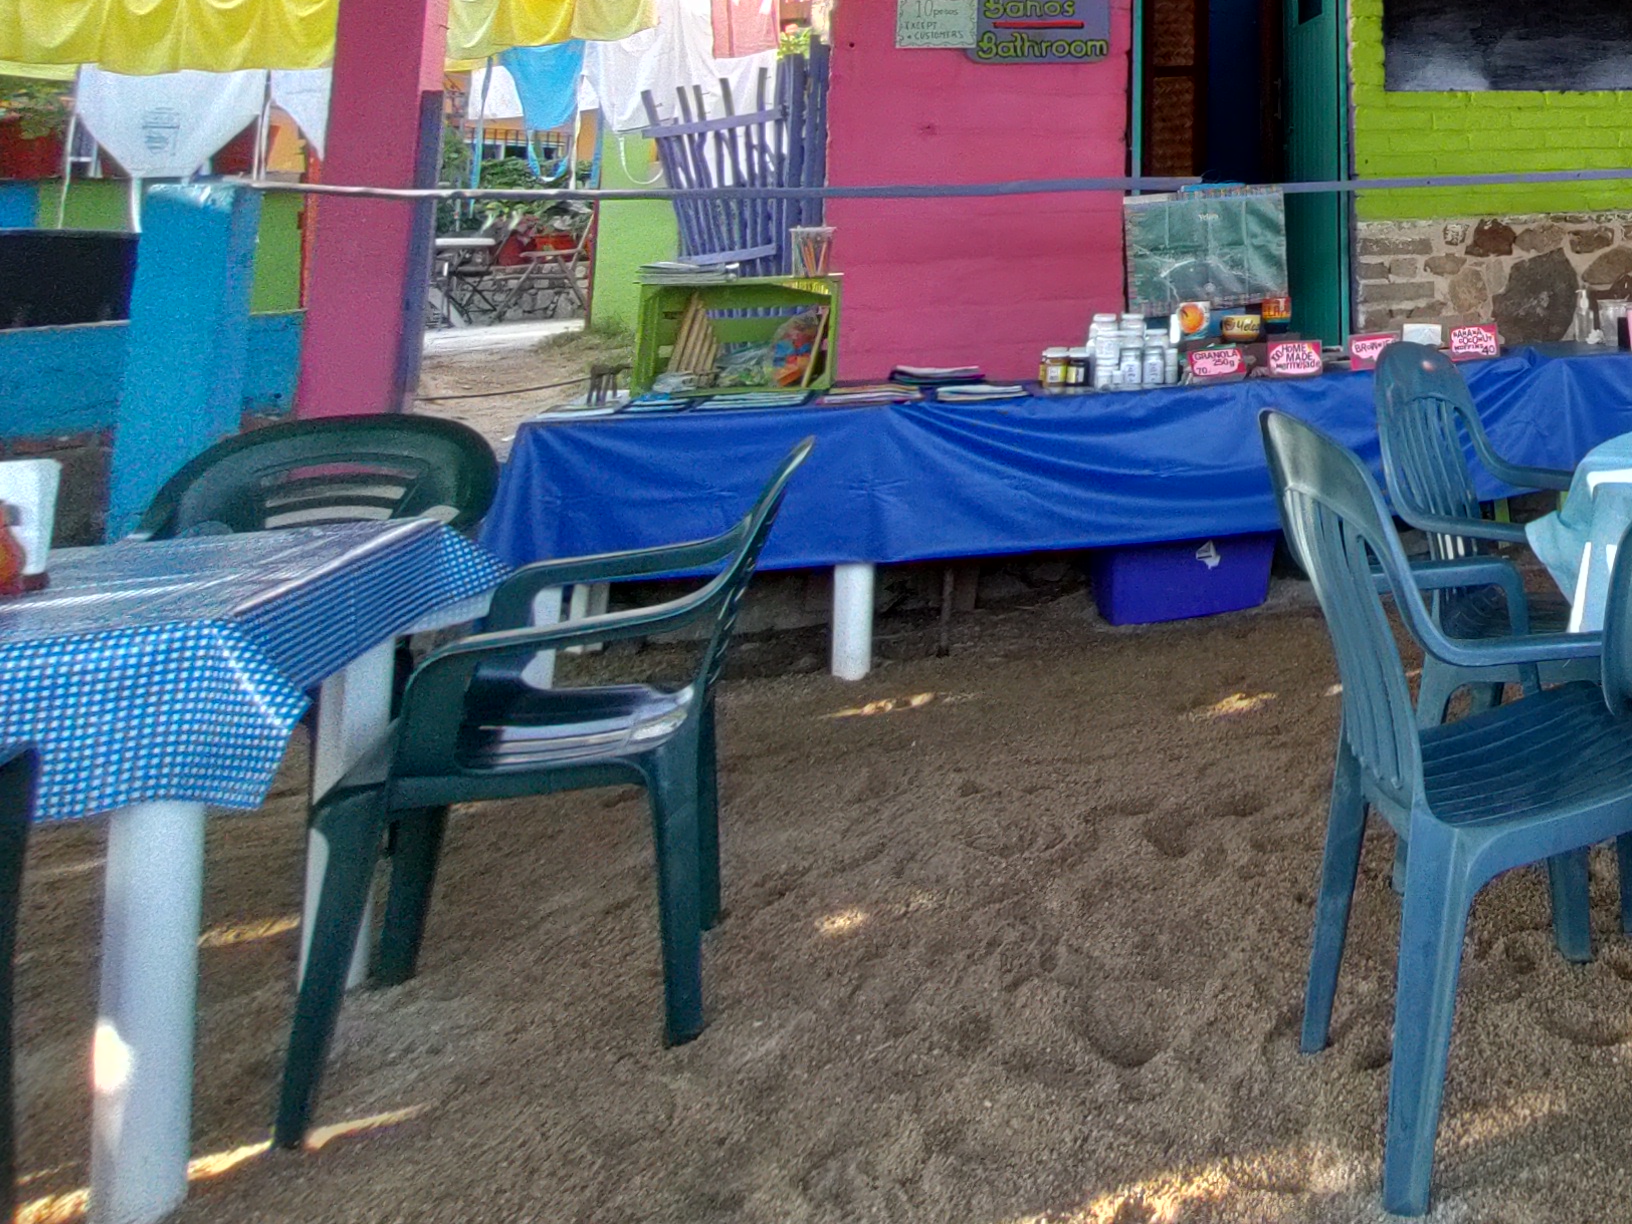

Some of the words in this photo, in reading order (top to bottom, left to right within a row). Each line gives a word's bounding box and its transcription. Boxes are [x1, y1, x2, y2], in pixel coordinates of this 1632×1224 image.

[916, 0, 933, 18] 10
[977, 31, 1109, 59] Bathroom
[1458, 334, 1493, 345] COCONUT
[1282, 344, 1306, 353] HOME
[1482, 345, 1495, 355] 40
[1194, 350, 1238, 360] GRANOLA
[1286, 352, 1313, 362] MADE
